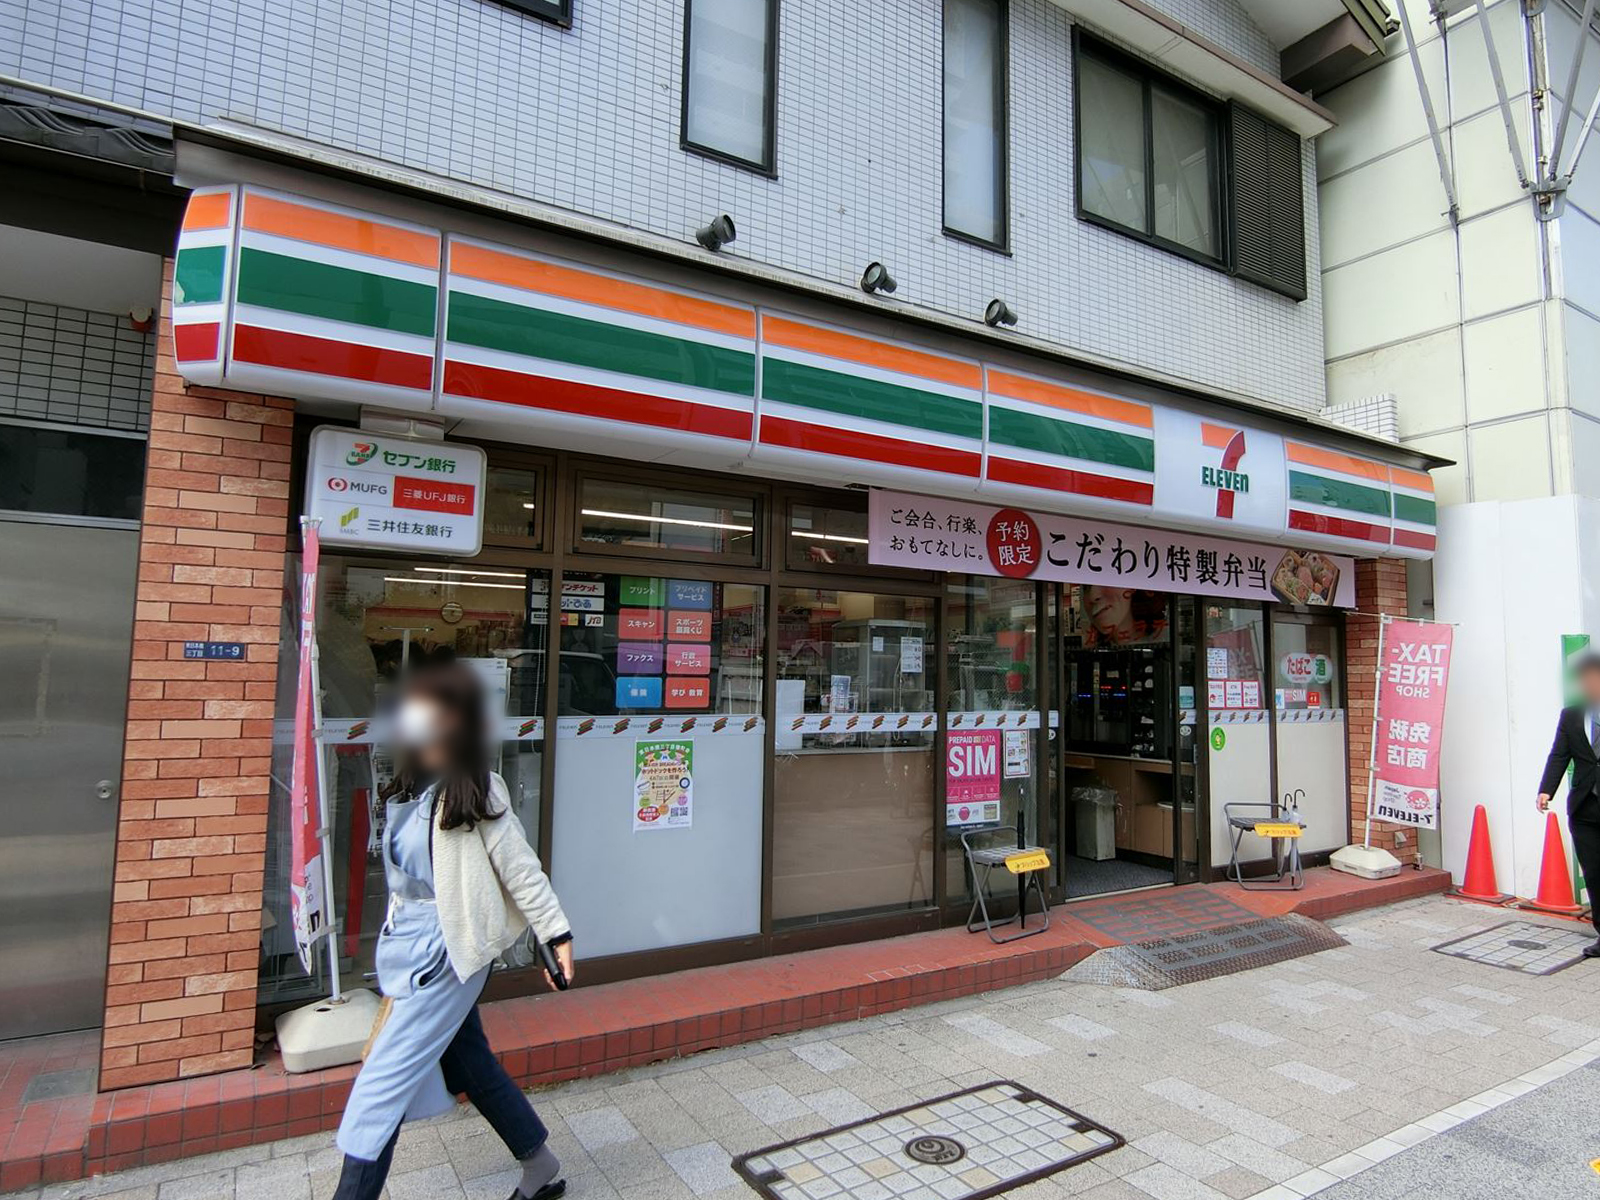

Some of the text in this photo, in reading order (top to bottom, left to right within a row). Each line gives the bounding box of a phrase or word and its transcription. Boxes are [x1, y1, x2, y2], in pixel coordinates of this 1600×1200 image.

[383, 450, 457, 474] セブン銀行
[350, 481, 388, 496] MUFG
[403, 488, 466, 504] 三菱UFJ銀行
[367, 518, 454, 538] 三井住友銀行
[890, 509, 983, 536] ご会合、行楽、
[996, 520, 1029, 542] 予約
[889, 535, 984, 561] おもてなしに。
[998, 545, 1035, 566] 限定
[1047, 531, 1267, 591] こだわり特製弁当
[630, 586, 656, 595] プリント
[677, 593, 705, 601] サービス
[628, 620, 655, 628] スキャン
[676, 618, 704, 626] スポーツ
[211, 645, 240, 656] 11-9
[626, 653, 654, 662] ファクス
[1287, 656, 1312, 677] たばこ
[1315, 658, 1326, 677] 酒
[949, 735, 973, 744] PREPAID
[949, 745, 996, 777] SIM
